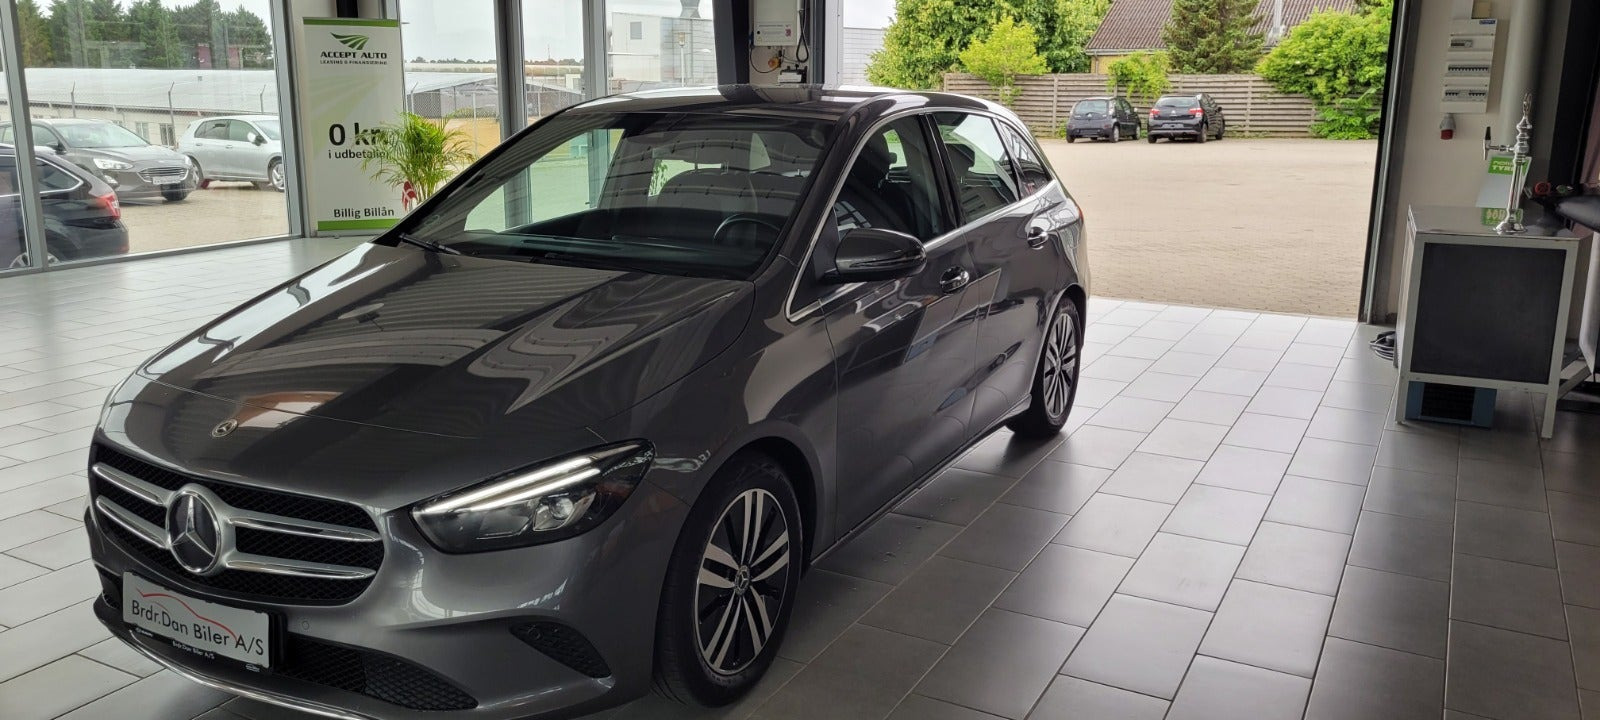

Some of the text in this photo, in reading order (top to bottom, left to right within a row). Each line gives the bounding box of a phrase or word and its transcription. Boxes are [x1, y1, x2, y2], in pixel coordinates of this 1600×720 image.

[320, 51, 357, 59] ACCEPT
[328, 123, 346, 146] 0
[328, 149, 332, 159] i
[333, 206, 395, 220] Billig Billån
[132, 600, 189, 636] Brdr.Dan
[193, 623, 230, 646] Biler
[235, 634, 264, 656] A/S
